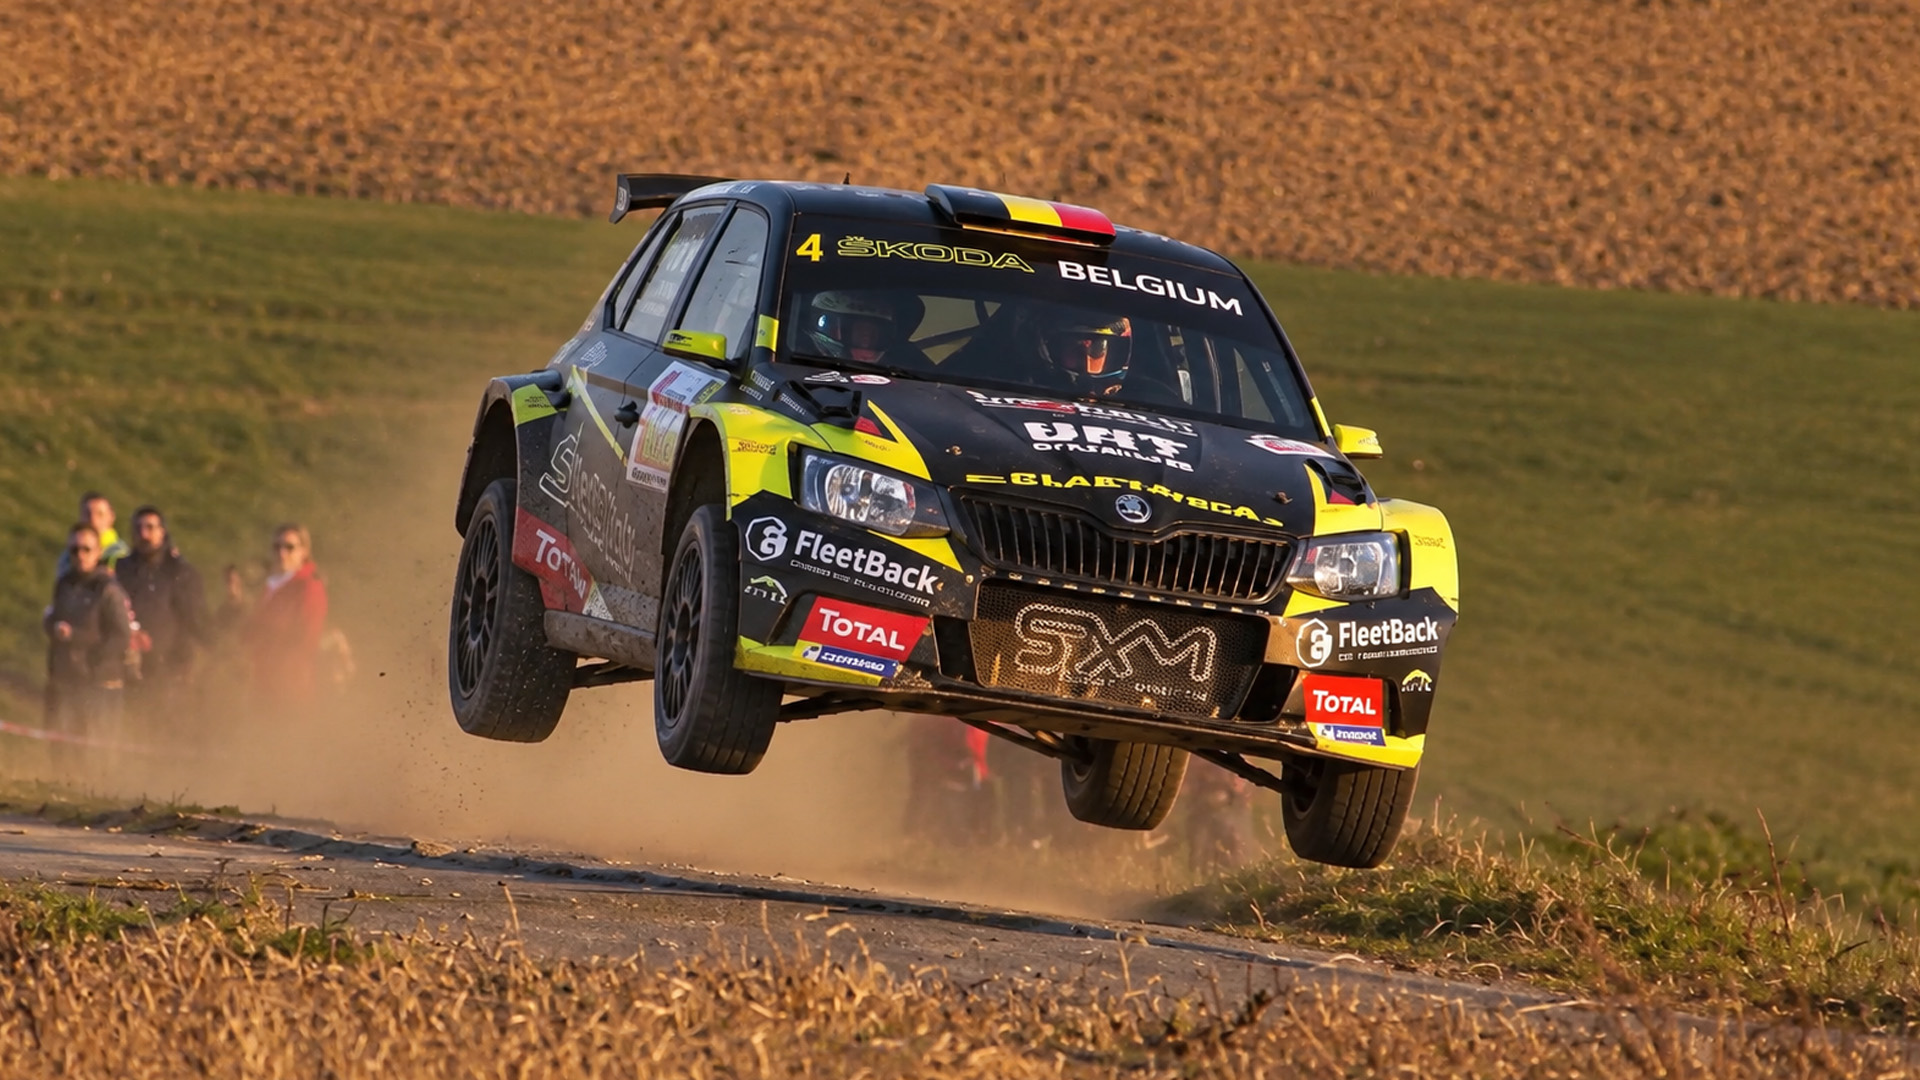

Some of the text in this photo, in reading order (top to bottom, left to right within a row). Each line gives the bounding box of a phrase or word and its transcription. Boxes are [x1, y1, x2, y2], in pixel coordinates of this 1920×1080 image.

[796, 233, 824, 262] 4
[837, 235, 1035, 274] ŠKODA
[1057, 260, 1243, 316] BELGIUM
[794, 529, 939, 595] FleetBack
[819, 607, 906, 651] TOTAL
[1338, 616, 1439, 648] FleetBack
[1312, 689, 1377, 715] TOTAL
